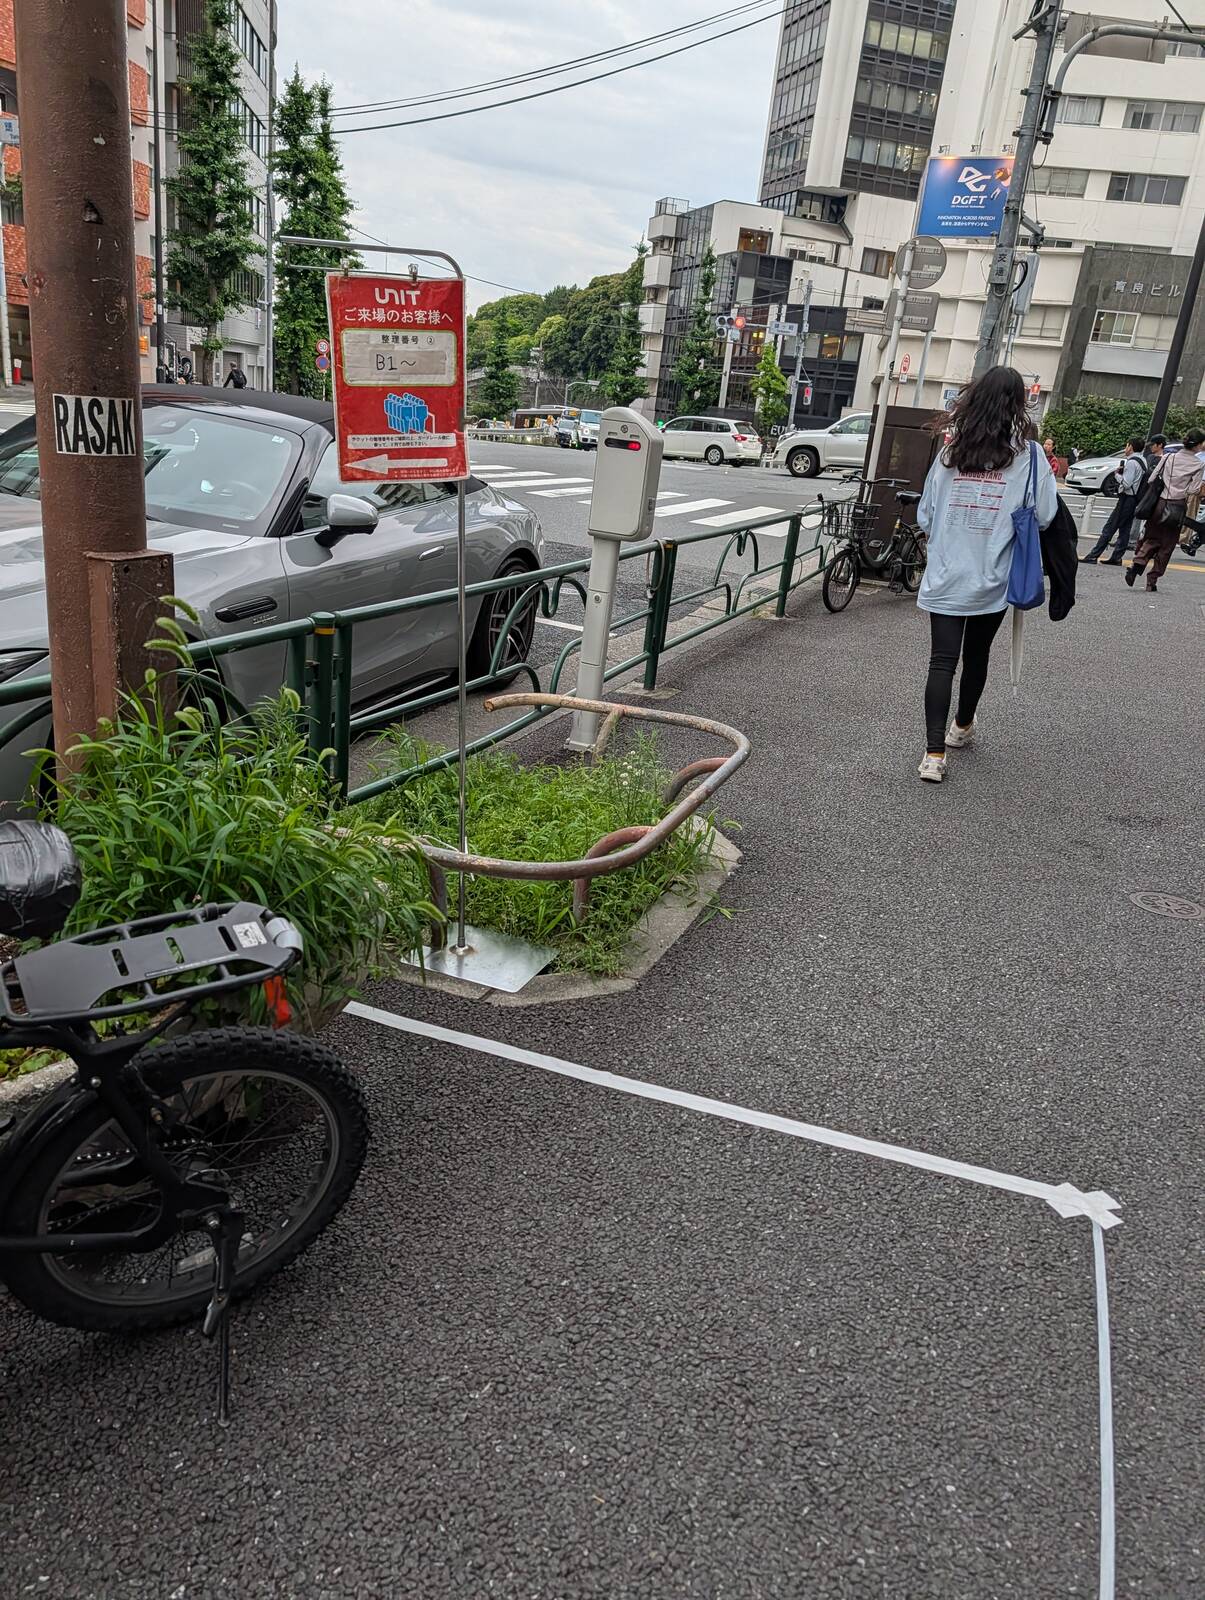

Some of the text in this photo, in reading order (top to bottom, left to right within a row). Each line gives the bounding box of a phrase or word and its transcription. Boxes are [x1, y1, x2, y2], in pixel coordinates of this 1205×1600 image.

[951, 195, 988, 205] DGFT
[374, 287, 421, 305] UNIT
[344, 307, 453, 325] ご来場のお客様へ
[381, 334, 419, 344] 整理番号
[54, 395, 135, 454] RASAK
